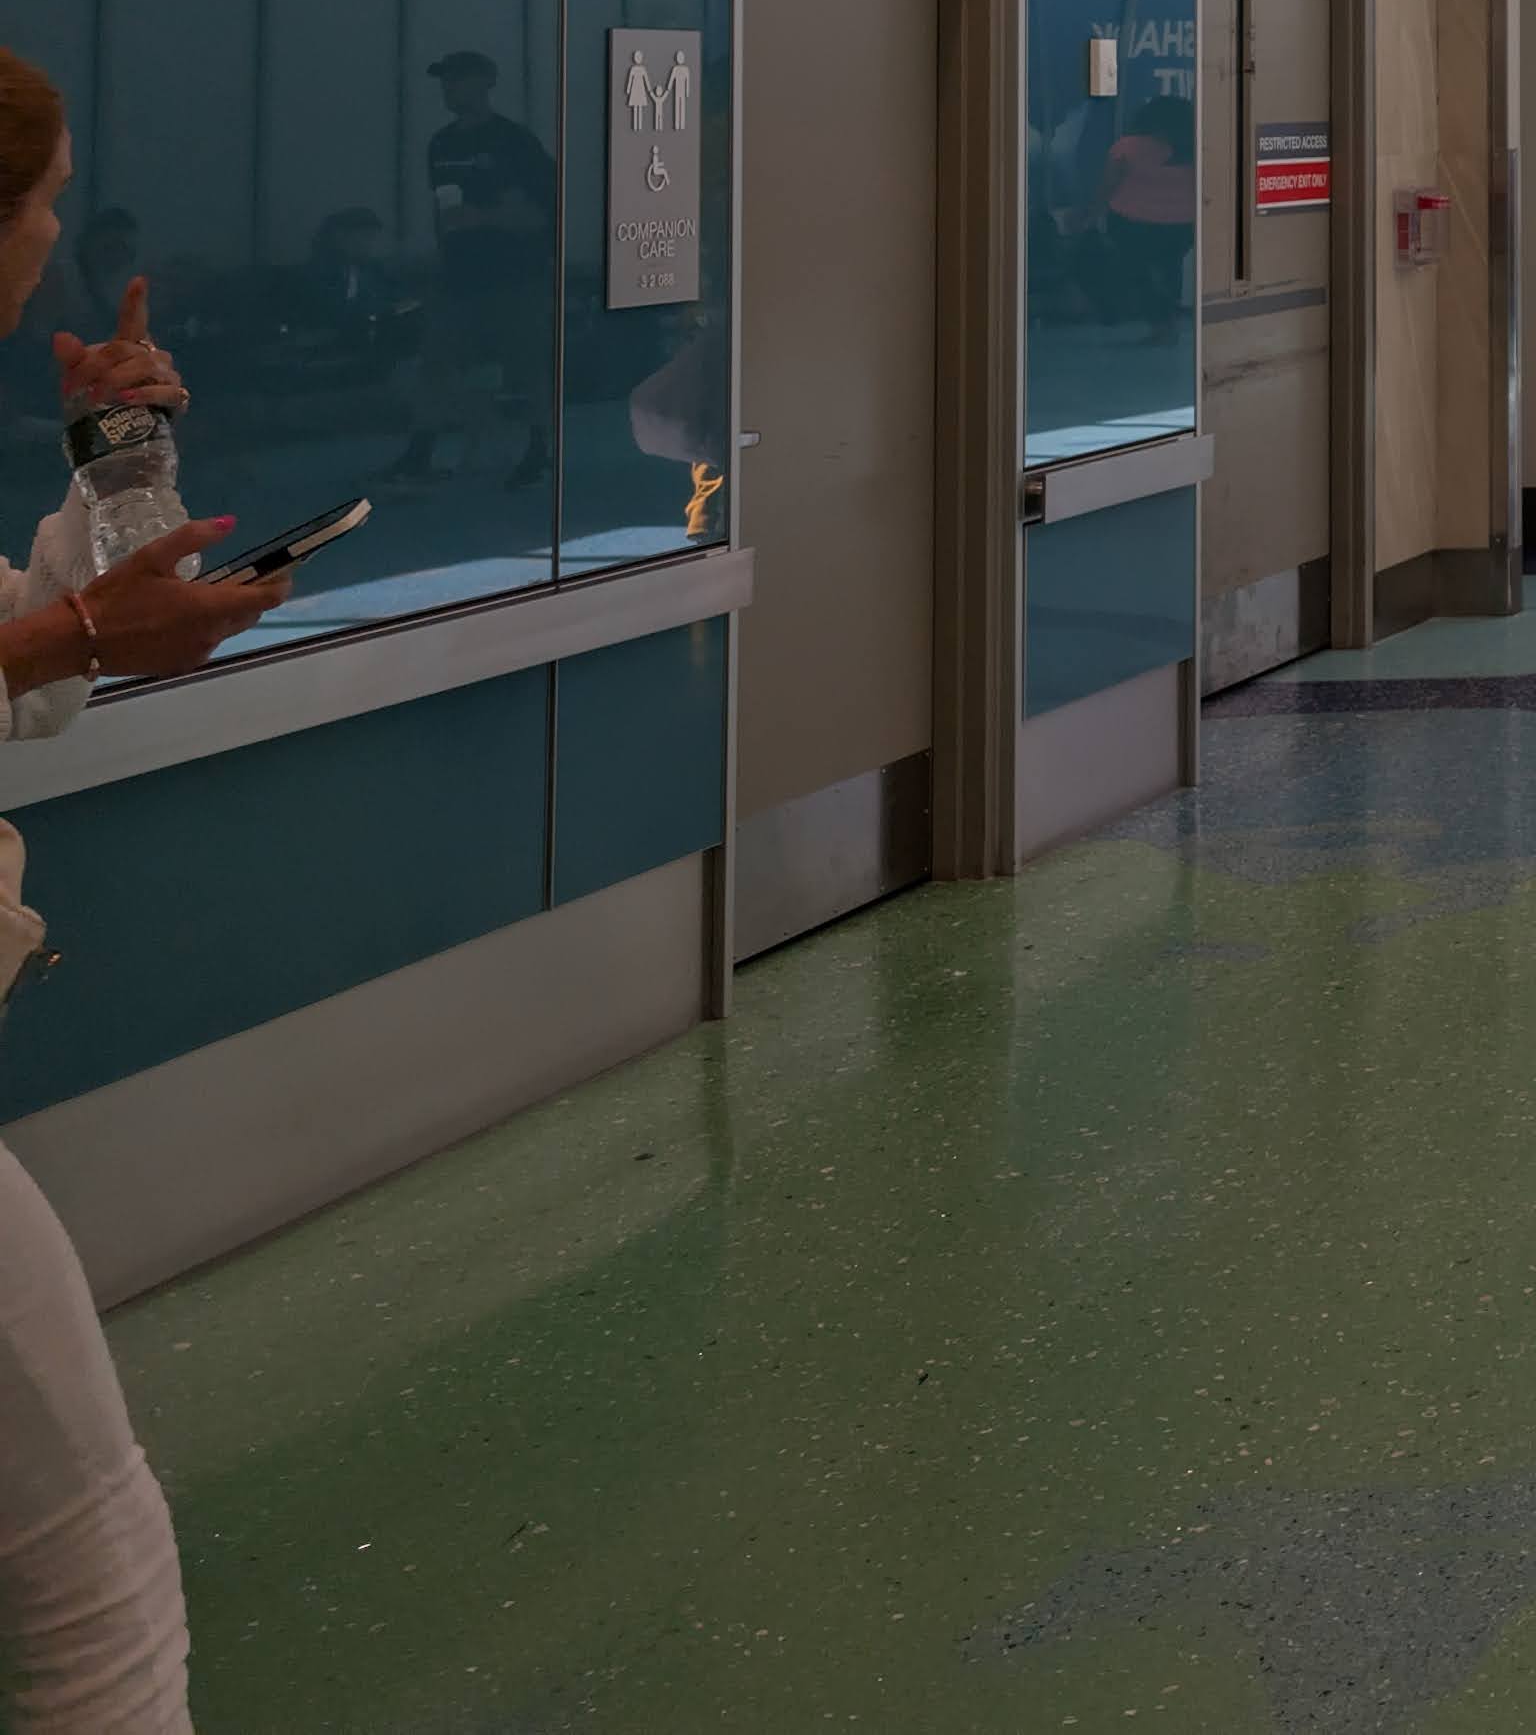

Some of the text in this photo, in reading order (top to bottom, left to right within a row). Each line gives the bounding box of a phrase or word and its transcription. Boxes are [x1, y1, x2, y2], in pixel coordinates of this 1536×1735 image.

[1259, 134, 1328, 151] RESTRICTED ACCESS
[1259, 174, 1328, 191] EMERGENCY EXIT ONLY
[618, 219, 697, 242] COMPANION
[640, 240, 676, 260] CARE
